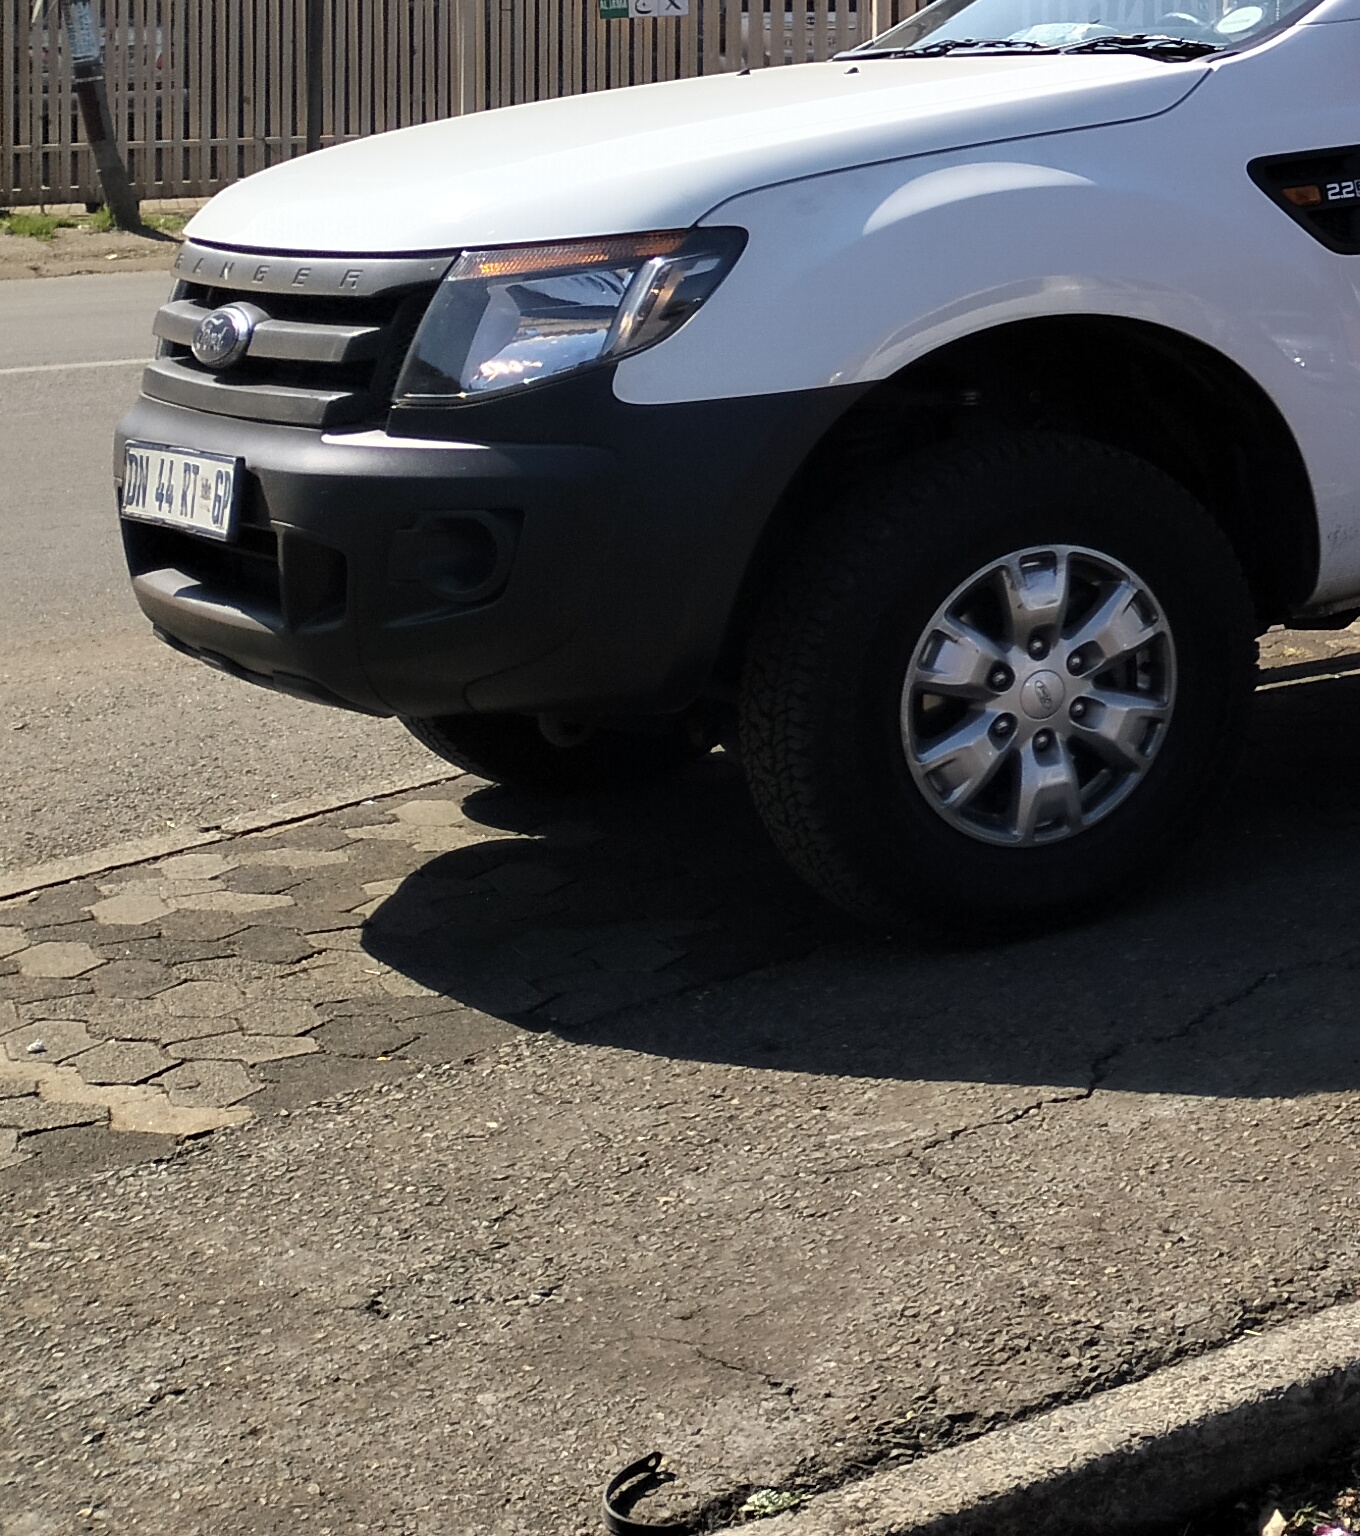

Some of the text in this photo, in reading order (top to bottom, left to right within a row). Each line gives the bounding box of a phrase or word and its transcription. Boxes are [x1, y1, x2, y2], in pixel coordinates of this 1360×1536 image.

[173, 252, 364, 291] RANGER
[196, 318, 229, 352] Ford
[125, 454, 231, 527] DN 44 RT GP
